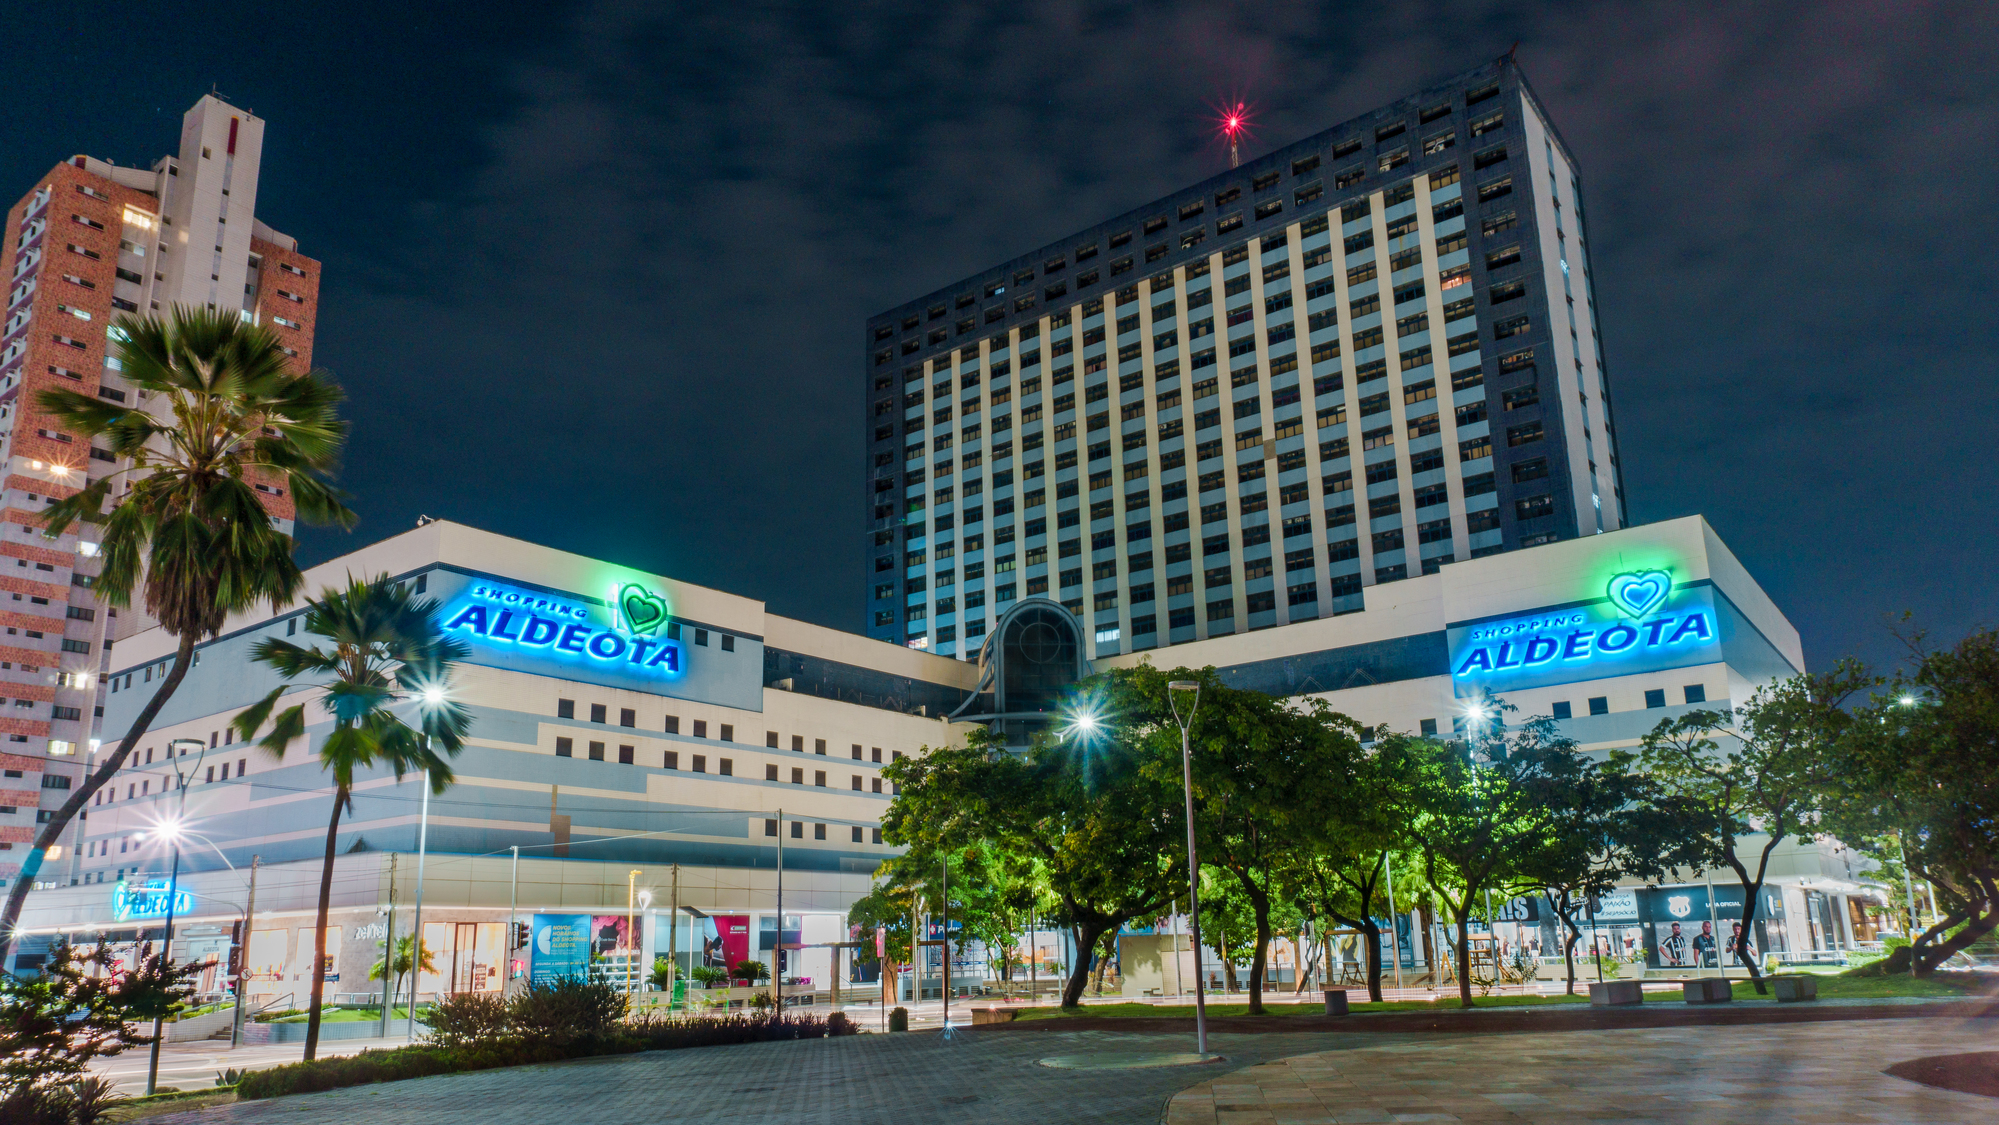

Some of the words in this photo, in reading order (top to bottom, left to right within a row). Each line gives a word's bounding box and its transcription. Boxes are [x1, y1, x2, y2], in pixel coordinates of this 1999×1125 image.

[474, 586, 588, 619] SHOPPING
[444, 604, 680, 673] ALDEOTA
[1472, 613, 1583, 640] SHOPPING
[1454, 612, 1713, 677] ALDEOTA
[131, 892, 186, 915] LDEOA
[1603, 899, 1631, 908] PAIXÃO
